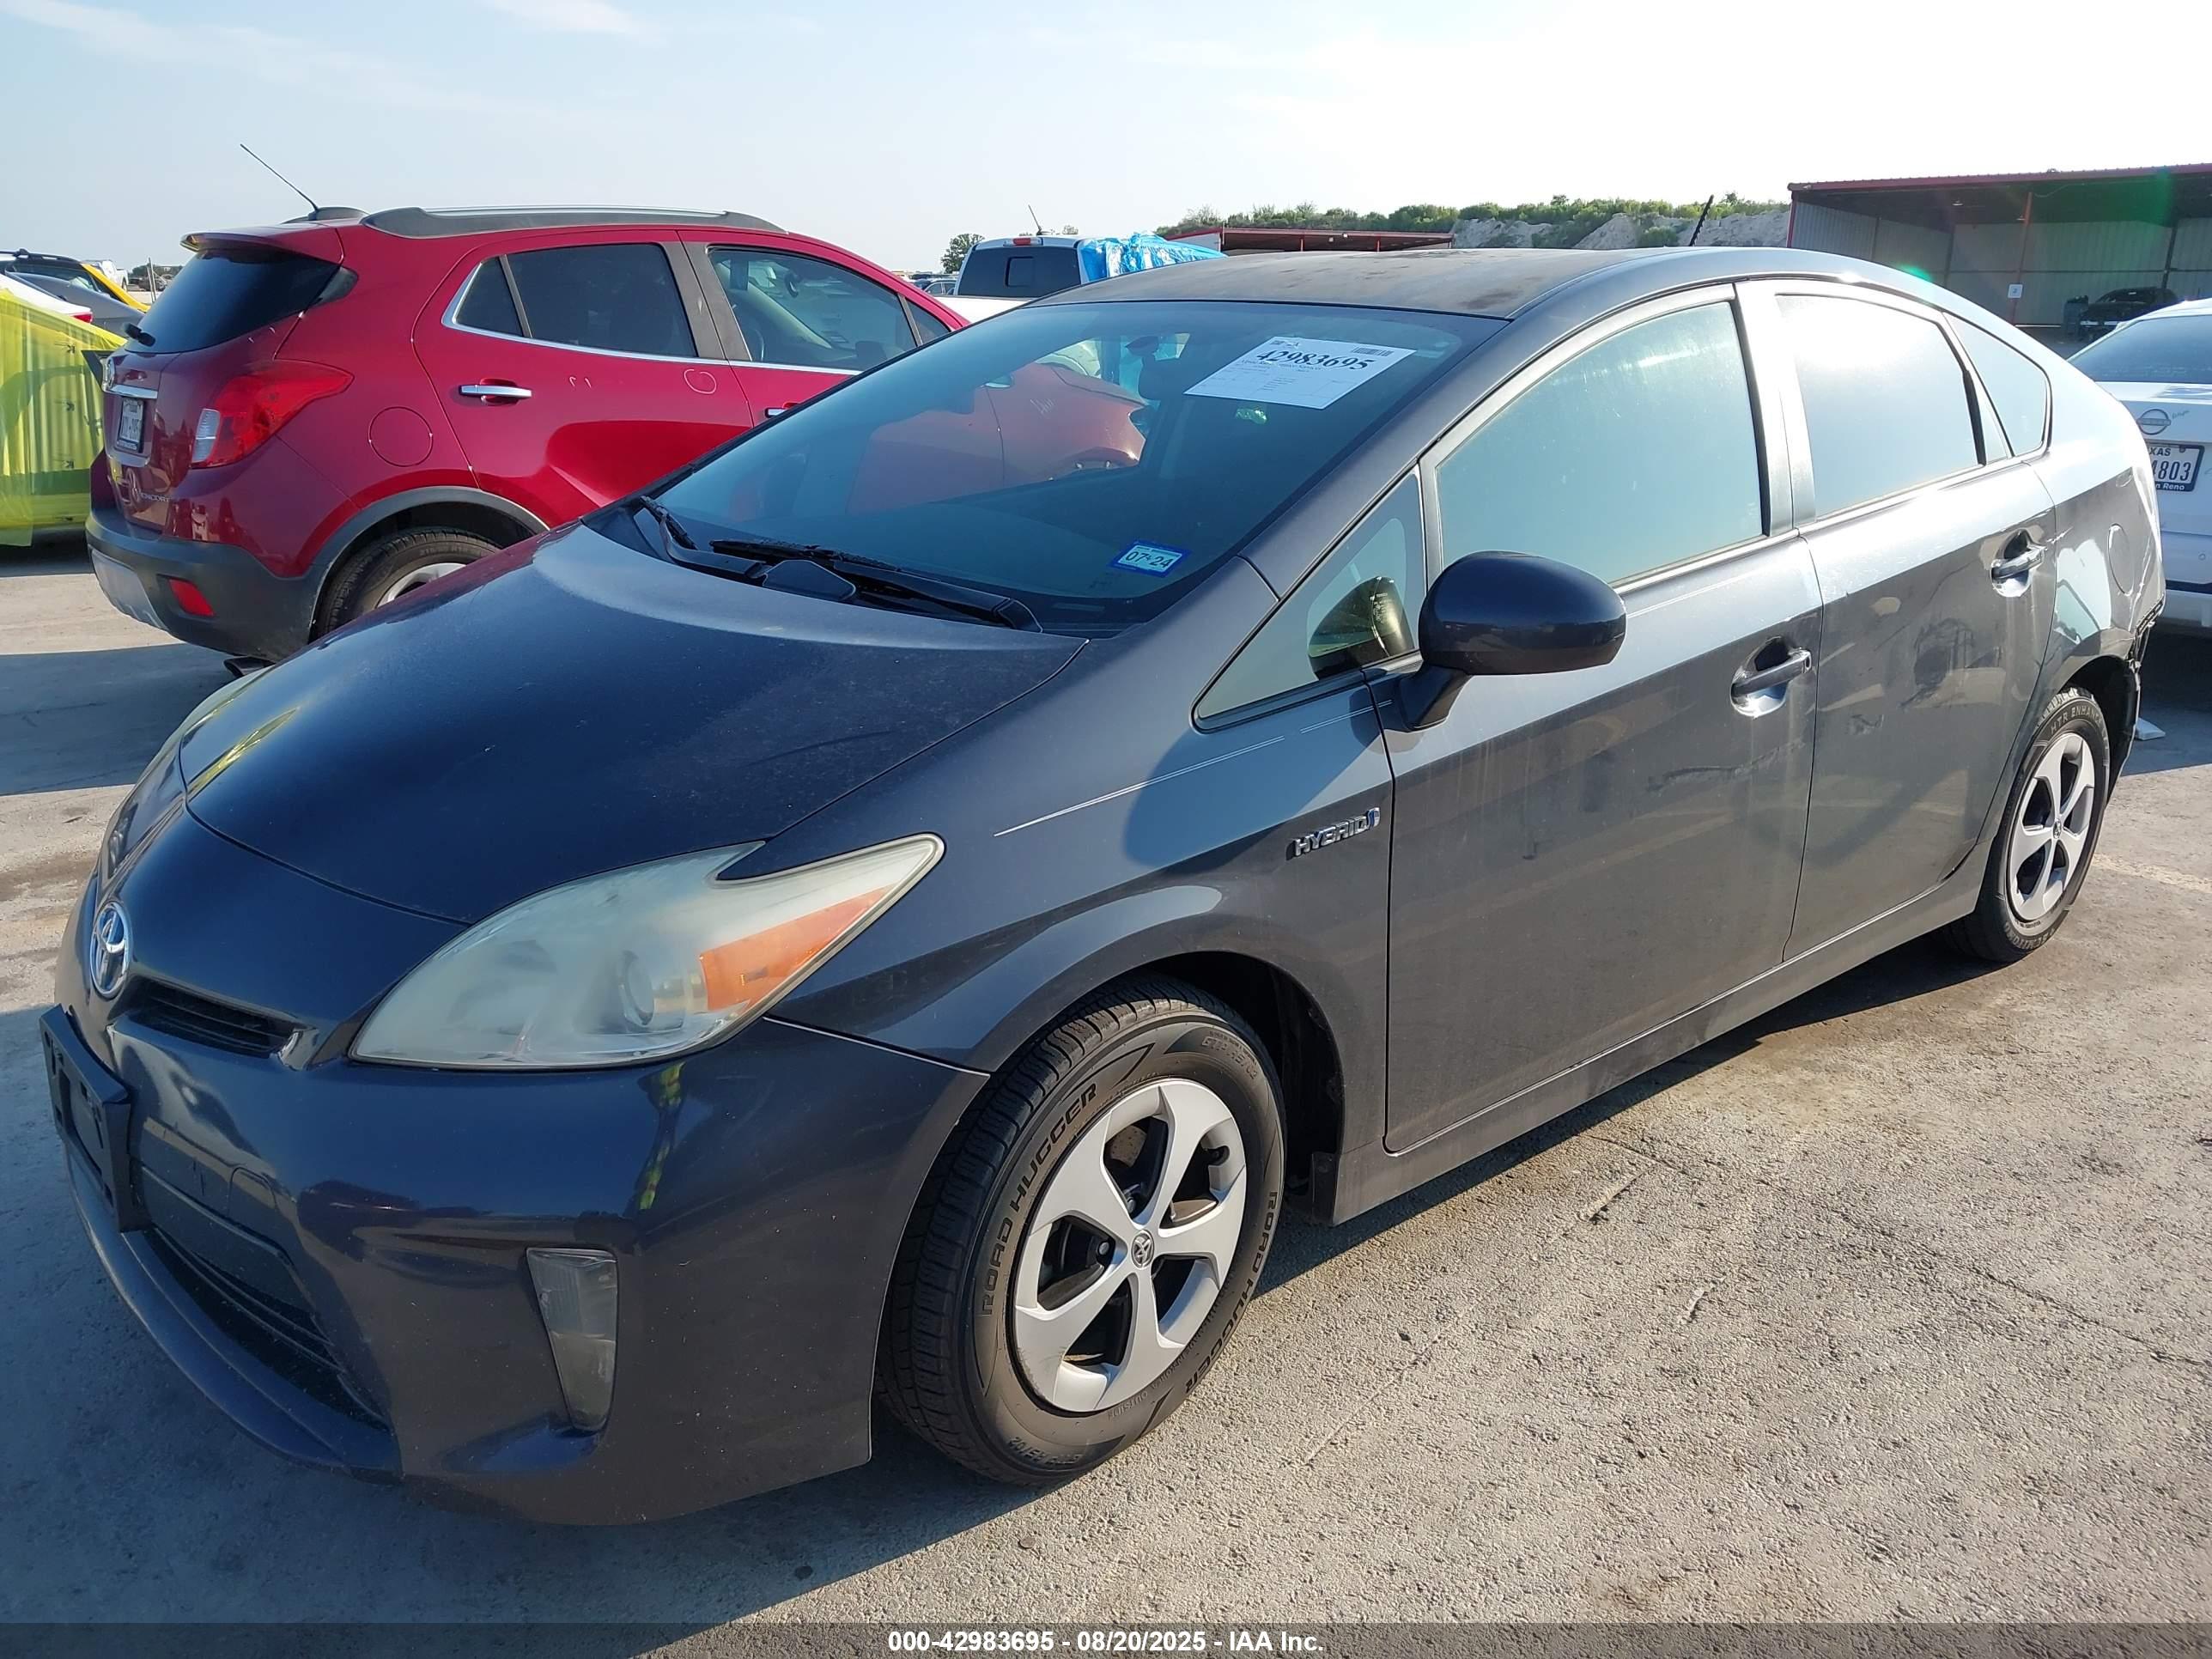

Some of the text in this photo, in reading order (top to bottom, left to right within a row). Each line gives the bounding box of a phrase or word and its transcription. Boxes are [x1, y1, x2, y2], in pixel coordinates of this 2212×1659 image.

[1256, 349, 1376, 371] 42983695
[2148, 447, 2171, 456] XAS
[2051, 713, 2069, 735] HTR
[1295, 815, 1368, 856] HYBRID
[981, 1083, 1098, 1316] ROAD HUGGER
[1250, 1190, 1278, 1273] ROAD
[1185, 1276, 1255, 1395] HUGGER
